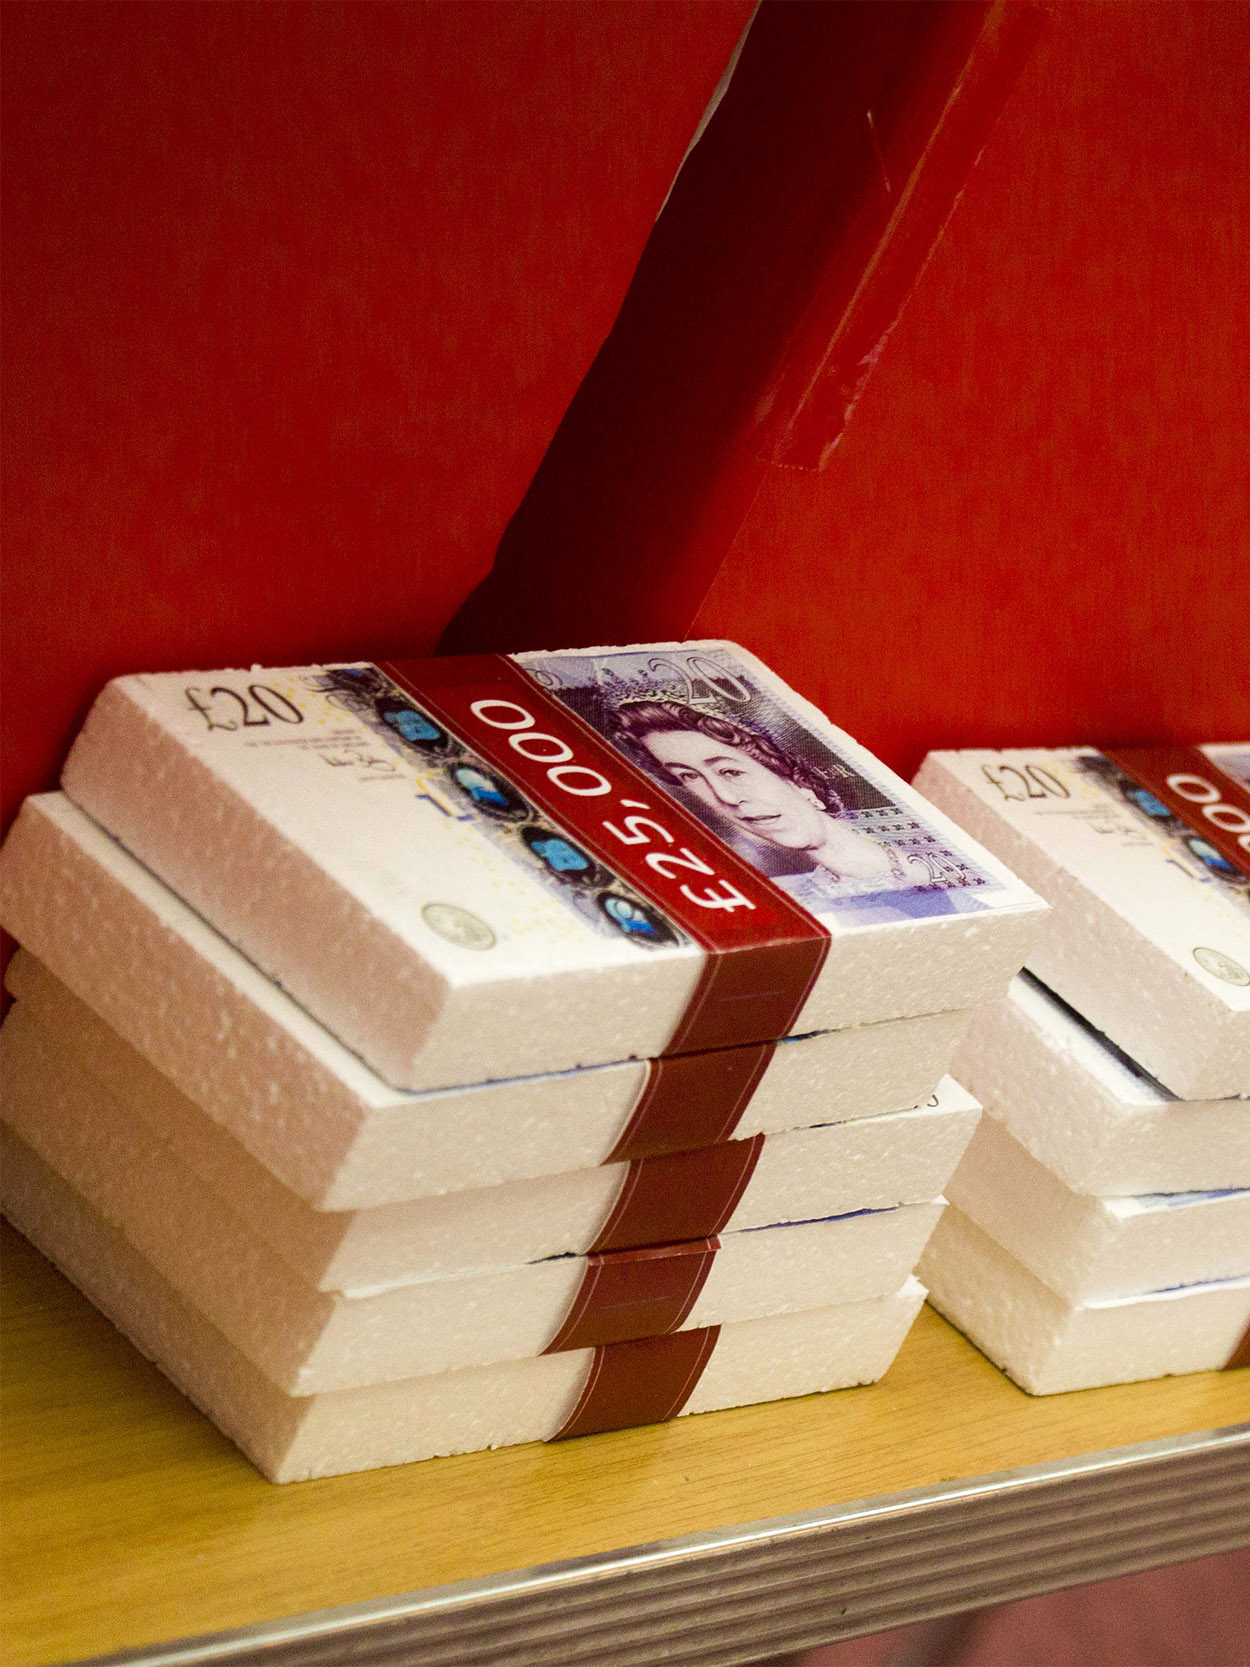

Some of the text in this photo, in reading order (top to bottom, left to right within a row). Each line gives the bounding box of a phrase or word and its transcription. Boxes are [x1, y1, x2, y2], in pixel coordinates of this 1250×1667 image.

[648, 657, 752, 705] 20
[184, 684, 304, 732] £20
[470, 699, 757, 912] £25,000
[981, 764, 1071, 802] £20
[907, 852, 967, 884] 20
